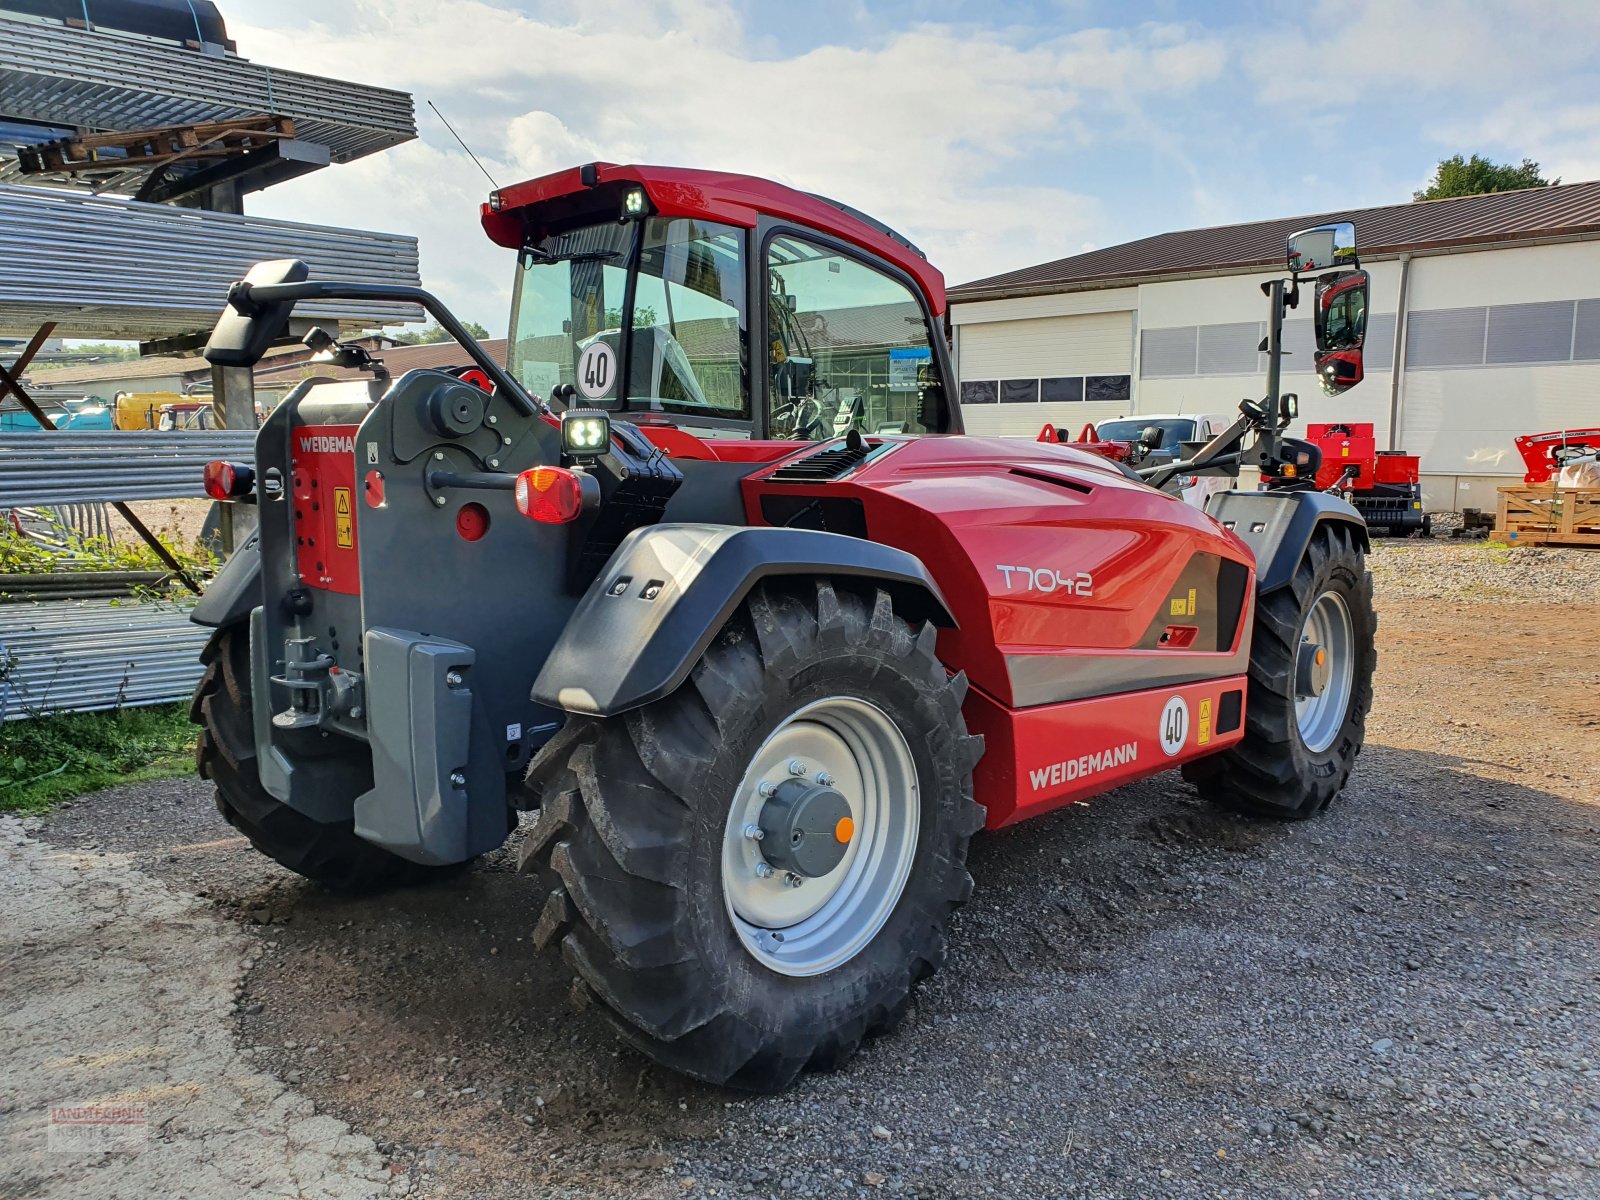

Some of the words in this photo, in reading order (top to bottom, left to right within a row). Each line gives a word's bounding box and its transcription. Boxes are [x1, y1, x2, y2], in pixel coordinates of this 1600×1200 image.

[585, 352, 608, 388] 40
[996, 564, 1093, 597] T7042
[1165, 706, 1183, 745] 40
[1029, 741, 1138, 791] WEIDEMANN
